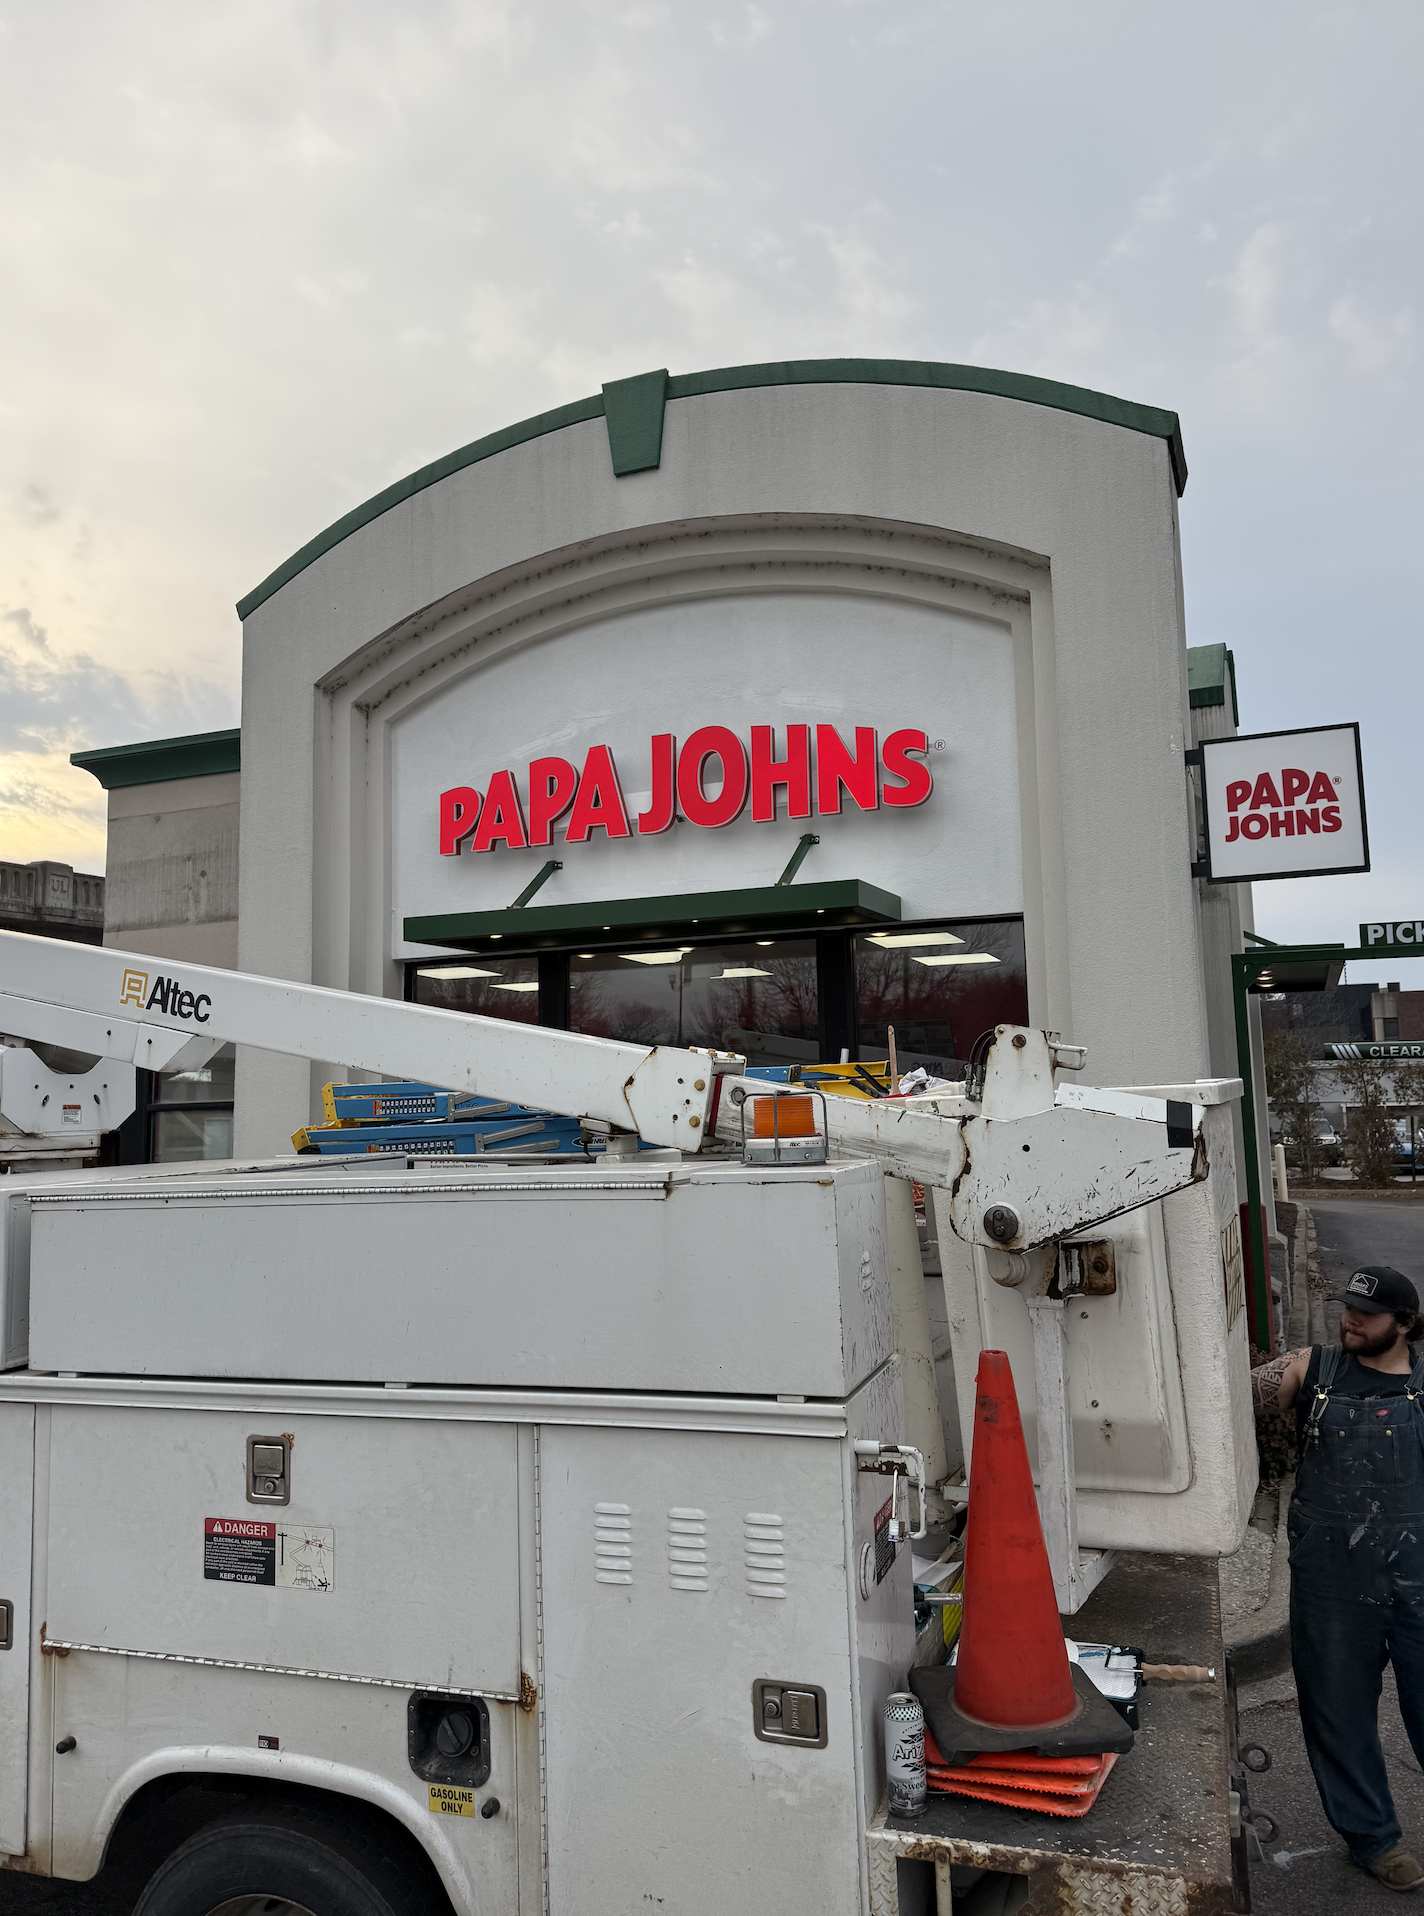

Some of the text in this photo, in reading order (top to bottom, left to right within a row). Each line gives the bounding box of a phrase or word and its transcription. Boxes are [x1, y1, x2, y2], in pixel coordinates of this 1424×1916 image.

[440, 723, 934, 857] PAPA JOHNS
[1225, 768, 1339, 813] PAPA
[1225, 805, 1343, 843] JOHNS
[145, 975, 212, 1023] Altec
[1369, 1045, 1424, 1058] CLEAR
[224, 1522, 268, 1536] DANGER
[219, 1572, 257, 1583] KEEP CLEAR
[430, 1787, 473, 1803] GASOLINE
[441, 1801, 463, 1814] ONLY
